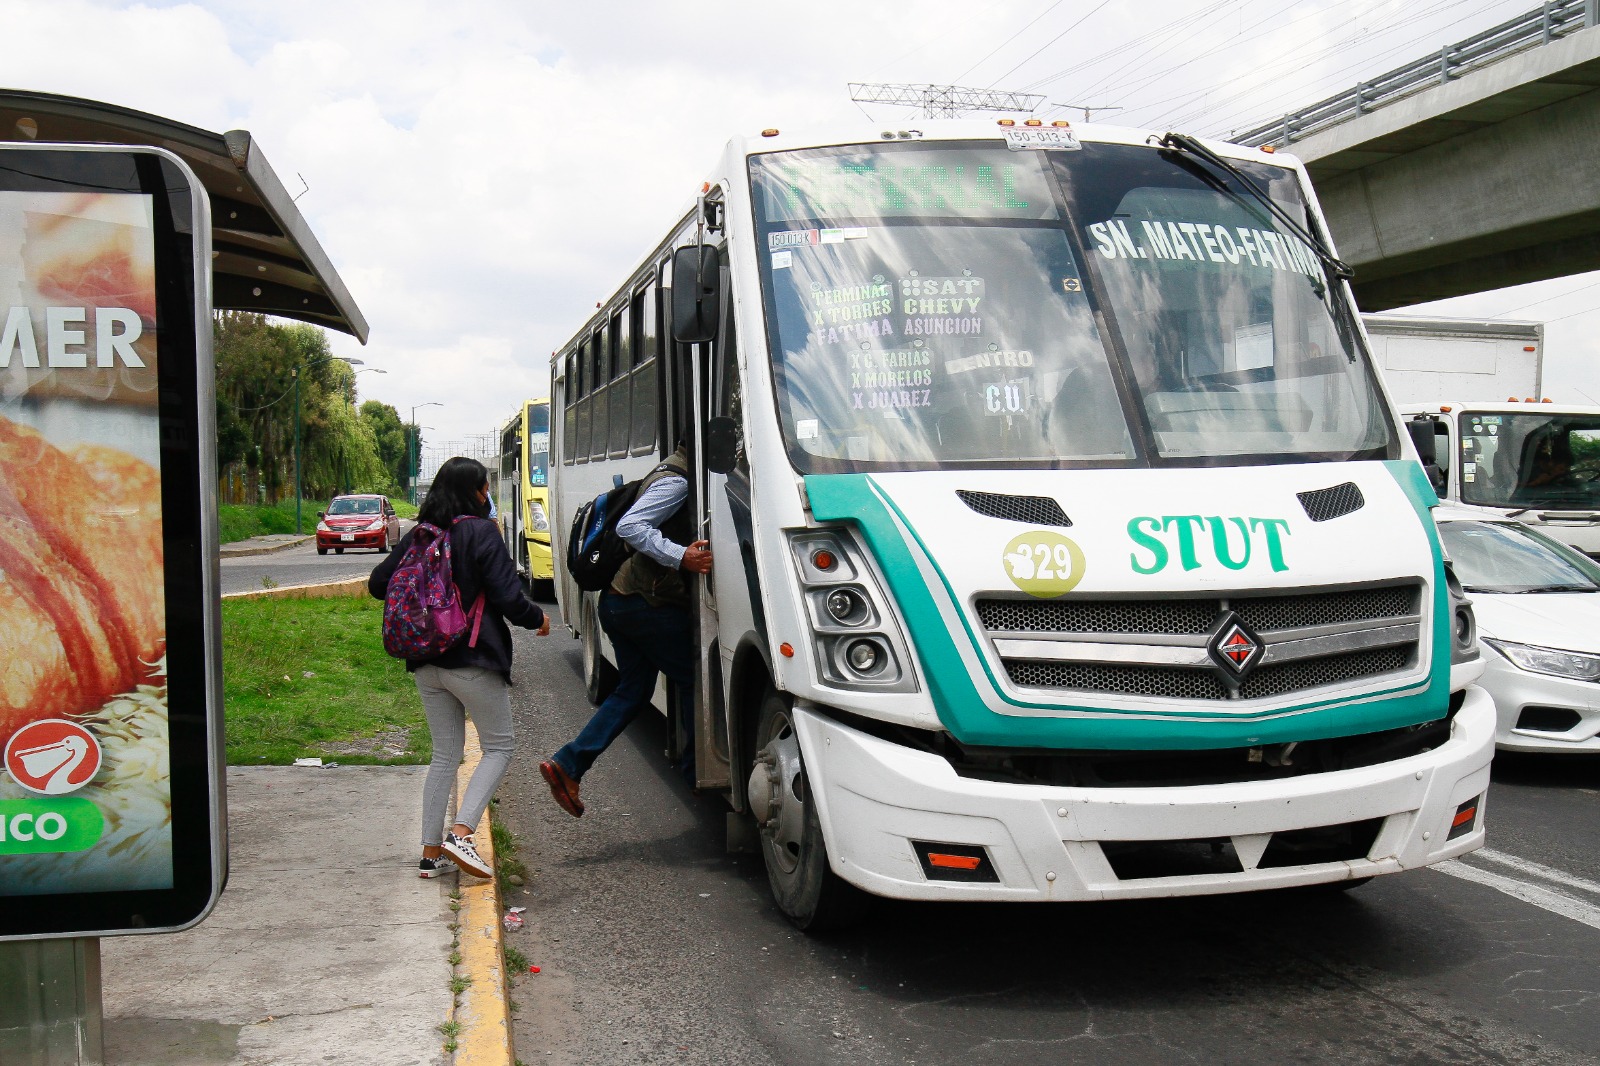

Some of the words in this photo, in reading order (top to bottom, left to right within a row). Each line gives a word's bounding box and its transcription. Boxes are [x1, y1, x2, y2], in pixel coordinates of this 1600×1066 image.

[1007, 132, 1077, 142] 150-013-K
[1089, 219, 1144, 260] SN.
[811, 284, 889, 306] TERMINAL
[922, 279, 981, 296] SAT
[813, 309, 825, 327] X
[827, 298, 893, 324] TORRES
[903, 297, 981, 316] CHEVY
[816, 318, 894, 346] FATIMA
[903, 317, 982, 336] ASUNCION
[851, 353, 861, 370] X
[881, 350, 931, 369] FARIAS
[851, 371, 862, 389] X
[864, 368, 932, 389] MORELOS
[852, 391, 864, 410] X
[868, 388, 932, 410] JUAREZ
[985, 383, 1025, 414] C.U.
[1126, 514, 1292, 575] STUT
